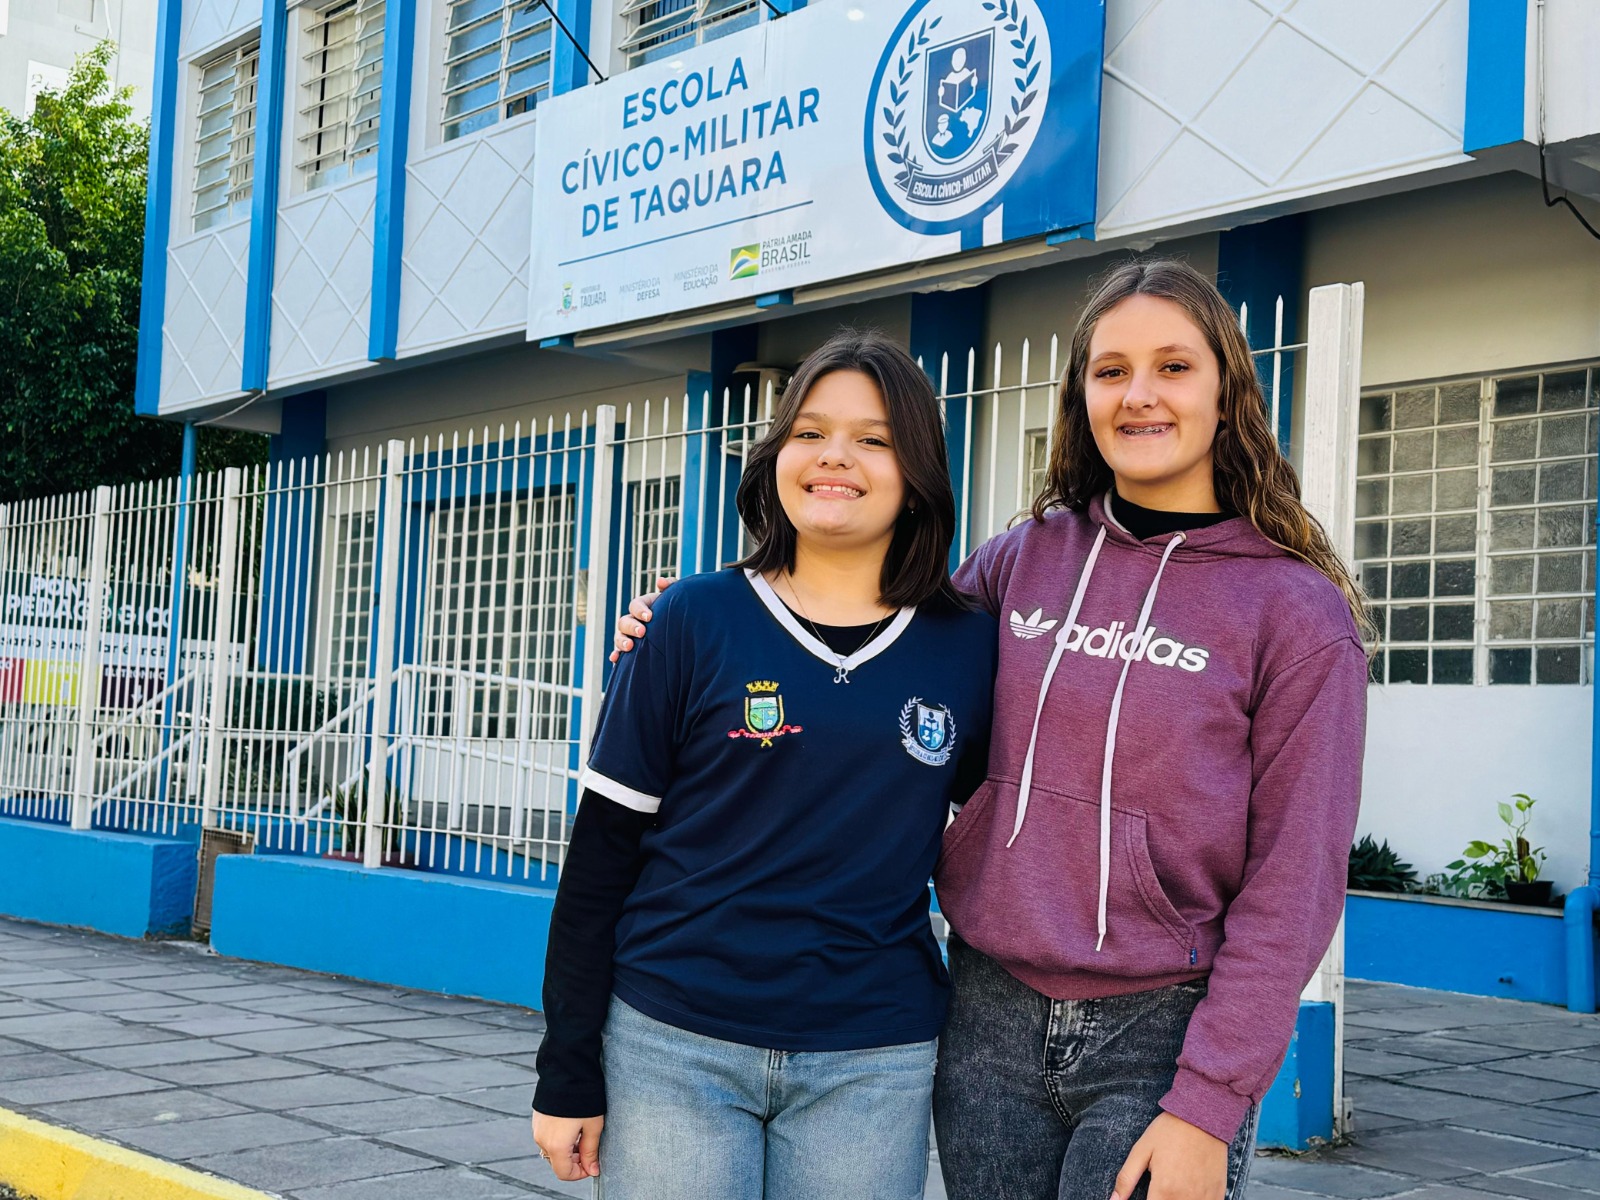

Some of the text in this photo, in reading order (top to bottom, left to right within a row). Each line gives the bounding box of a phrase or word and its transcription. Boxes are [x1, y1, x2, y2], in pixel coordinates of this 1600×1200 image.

[623, 57, 748, 129] ESCOLA
[562, 87, 820, 195] CÍVICO-MILITAR
[912, 162, 992, 198] ESCOLA CÍVICO-MILITAR
[582, 150, 787, 237] DE TAQUARA
[762, 230, 812, 250] PÁTRIA AMADA
[761, 242, 811, 268] BRASIL
[709, 263, 719, 275] DA
[636, 288, 661, 302] DEFESA
[683, 274, 718, 292] EDUCAÇÃO
[580, 291, 607, 308] TAQUARA
[33, 576, 113, 600] PONO
[1055, 620, 1210, 672] adidas
